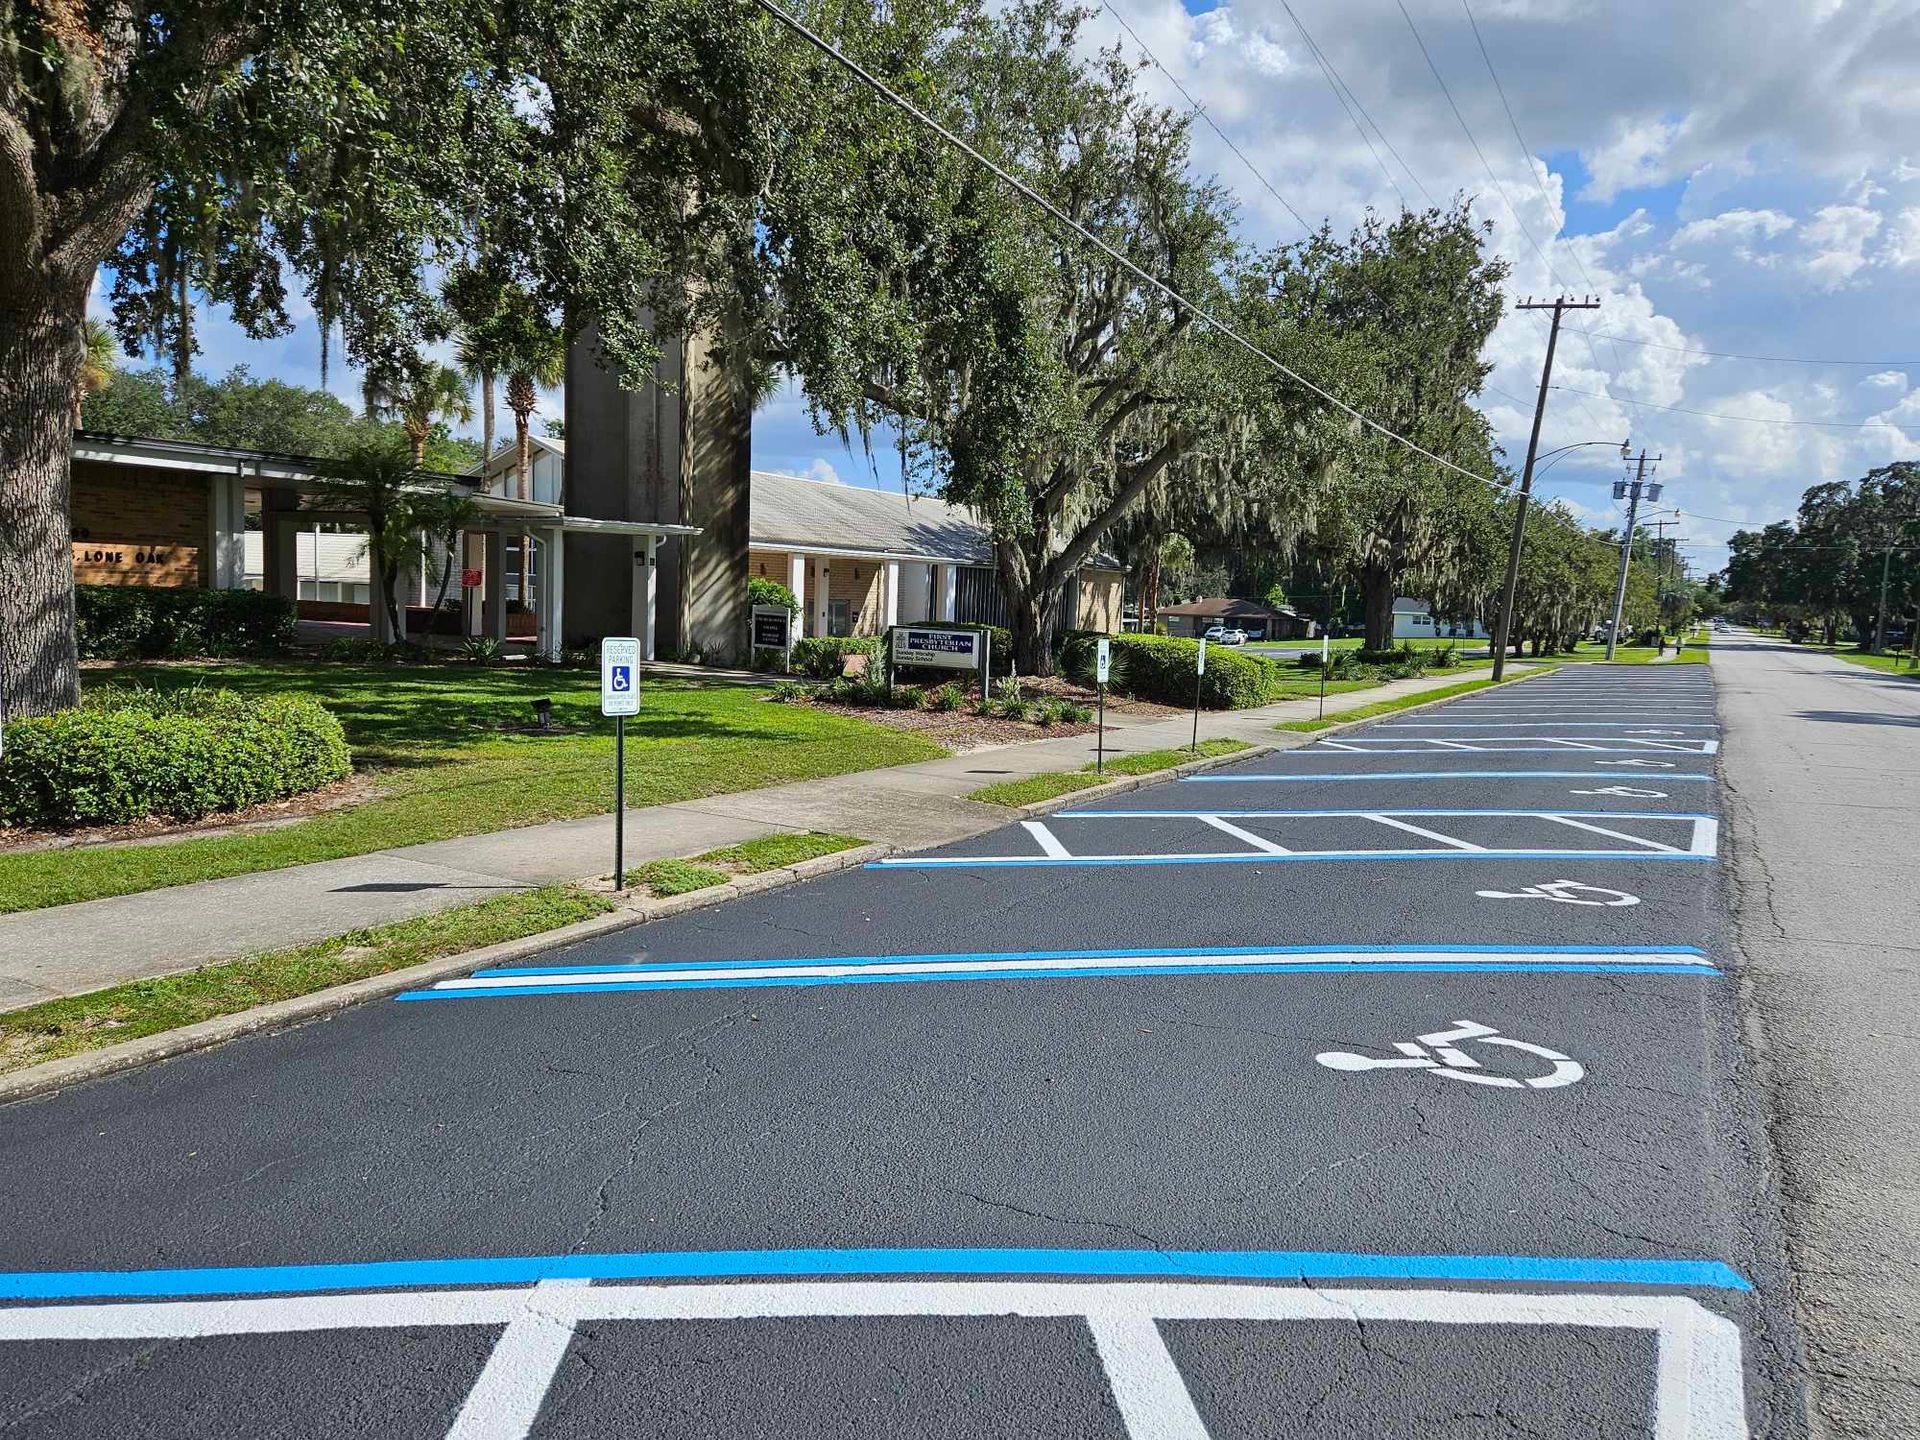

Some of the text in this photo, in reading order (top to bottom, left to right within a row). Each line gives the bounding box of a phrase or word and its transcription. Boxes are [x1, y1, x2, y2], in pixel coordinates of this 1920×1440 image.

[84, 550, 123, 563] LONE
[135, 551, 165, 564] OAK
[909, 637, 972, 647] PRESBYTERIAN
[606, 645, 637, 655] RESERVED
[921, 644, 959, 652] CHURCH
[608, 655, 634, 664] PARKING
